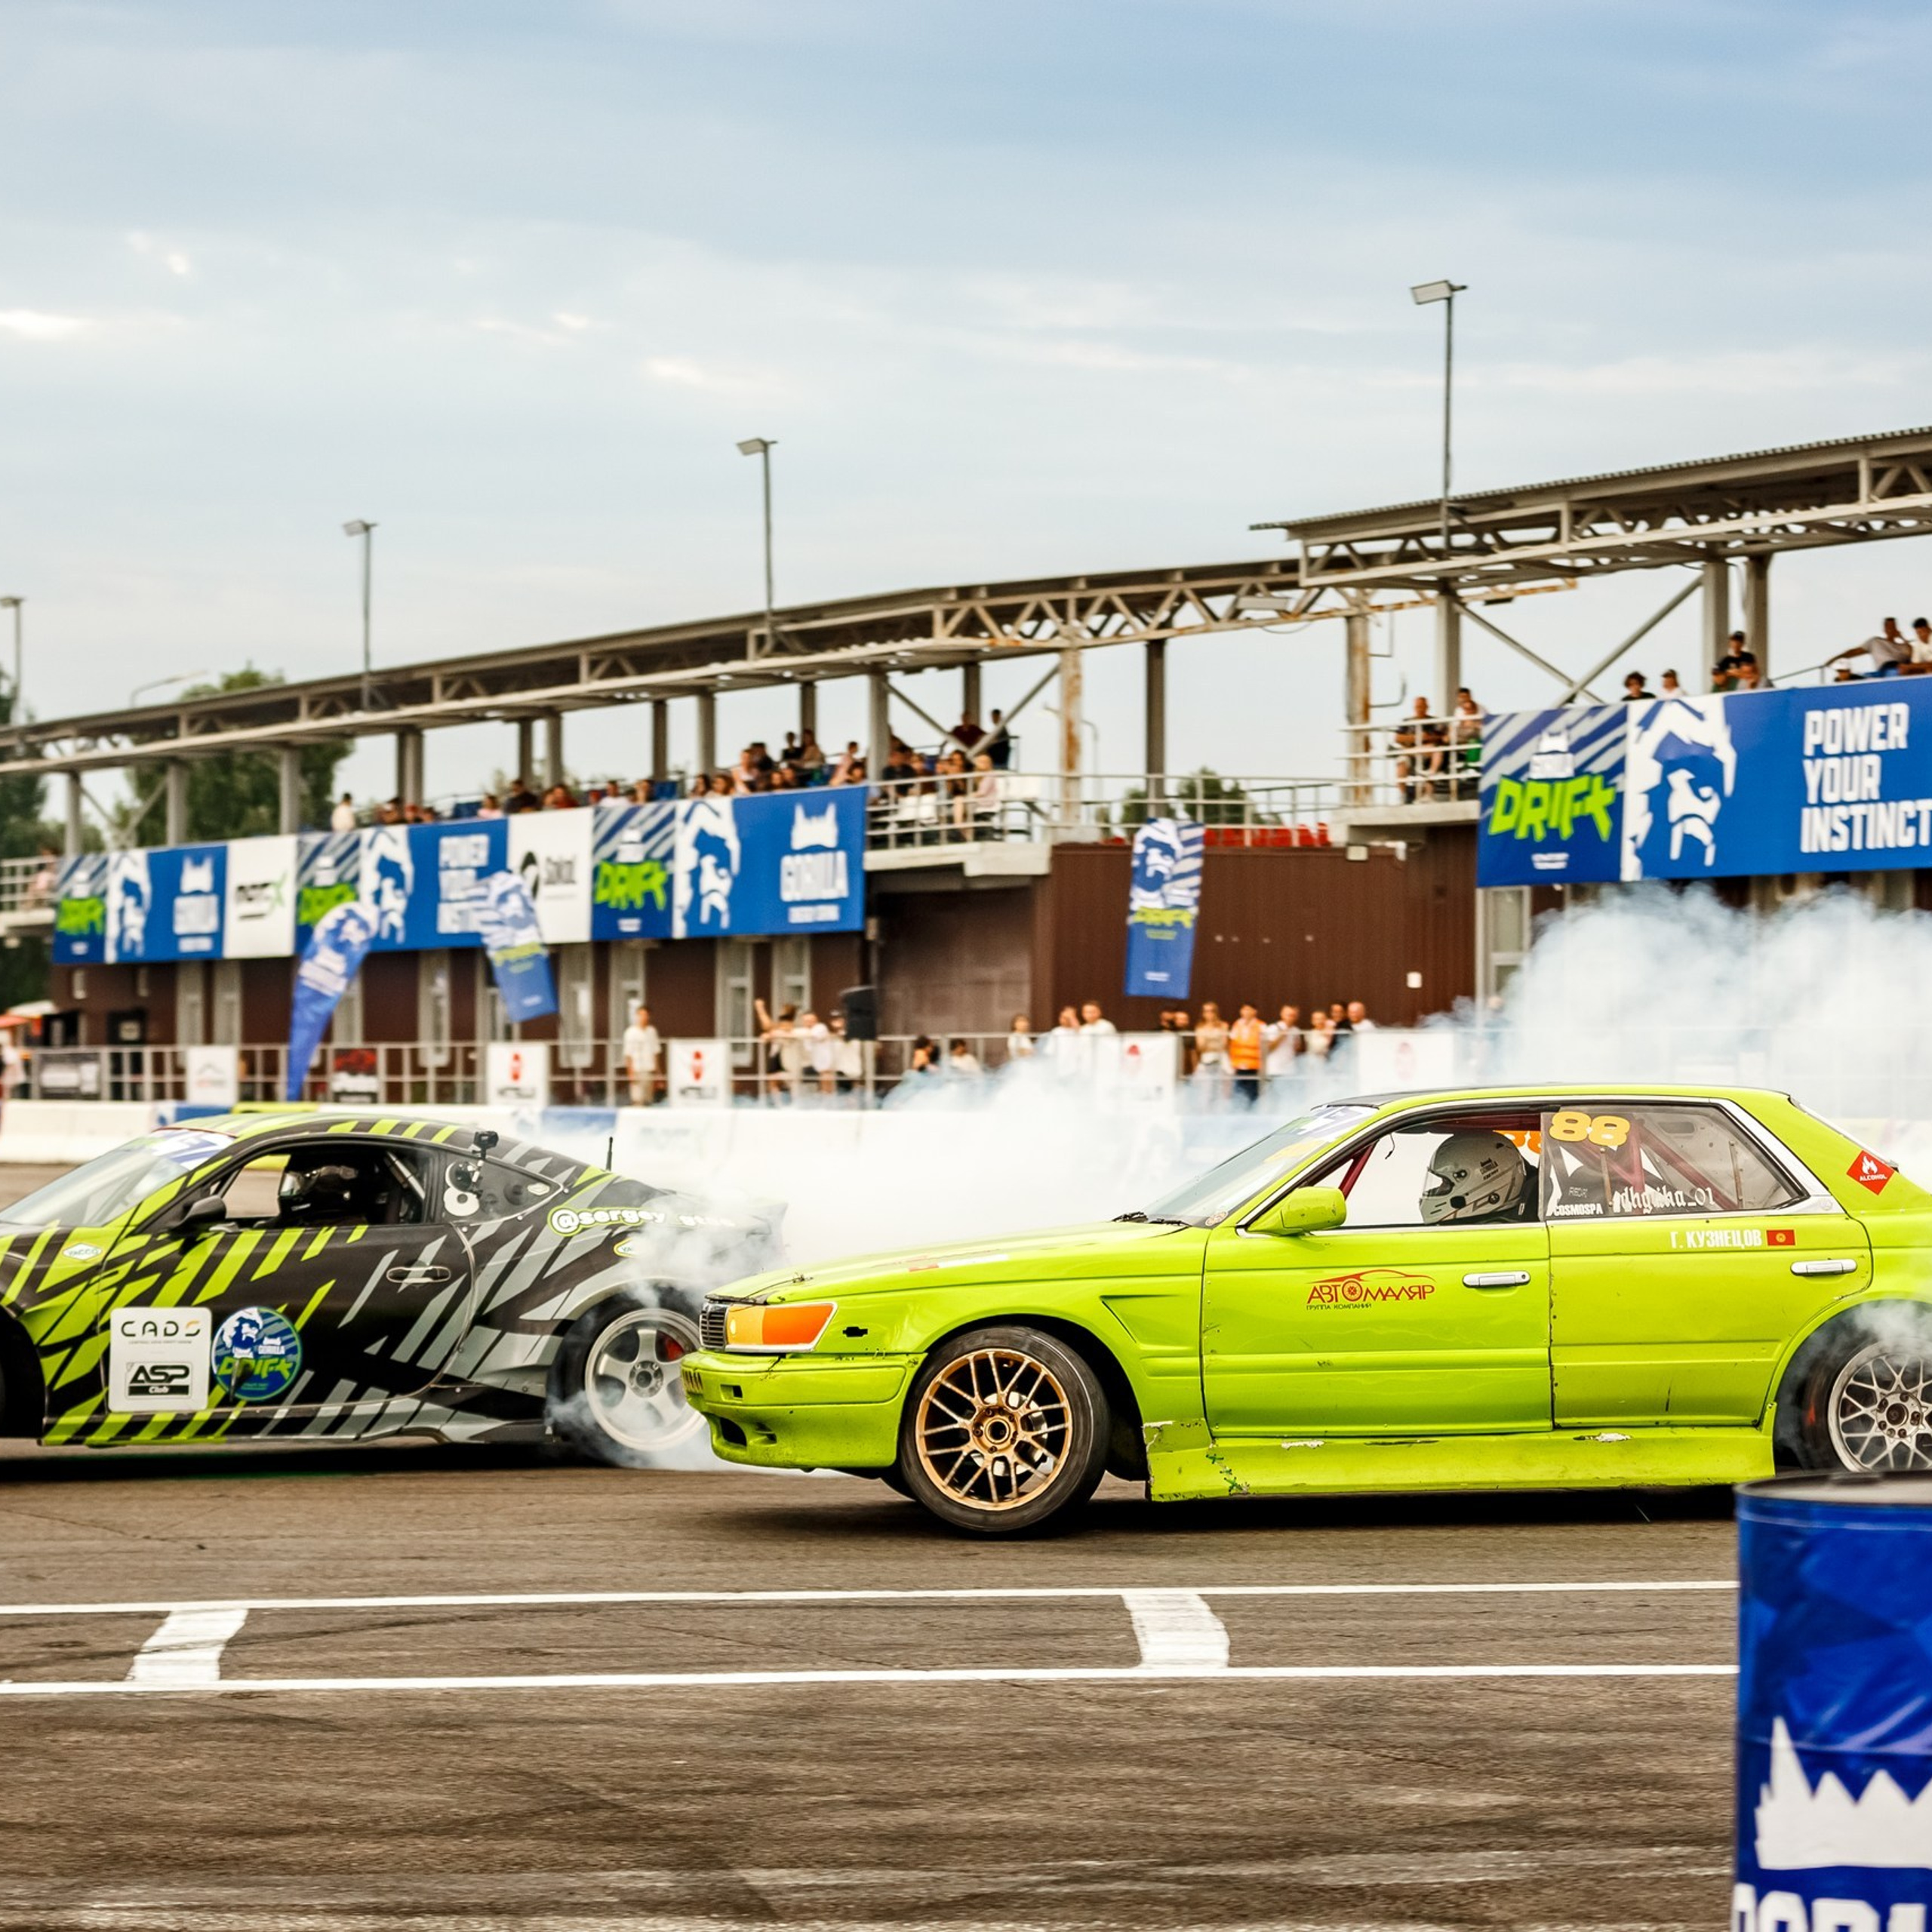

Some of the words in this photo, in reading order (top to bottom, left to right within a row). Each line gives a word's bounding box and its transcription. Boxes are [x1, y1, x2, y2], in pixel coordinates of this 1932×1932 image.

[1803, 702, 1910, 757] POWER
[1802, 753, 1882, 805] YOUR
[1487, 773, 1617, 843] DRIFT
[1799, 798, 1932, 854] INSTINCT
[1549, 1111, 1631, 1146] 88
[1859, 1174, 1887, 1182] ALCOHOL
[1669, 1231, 1684, 1249] Г.
[1686, 1229, 1762, 1250] КУЗНЕЦОВ
[1306, 1279, 1435, 1304] АВТОМАЛЯР
[121, 1320, 201, 1337] CADS
[130, 1364, 189, 1384] ASP
[148, 1386, 170, 1394] Club
